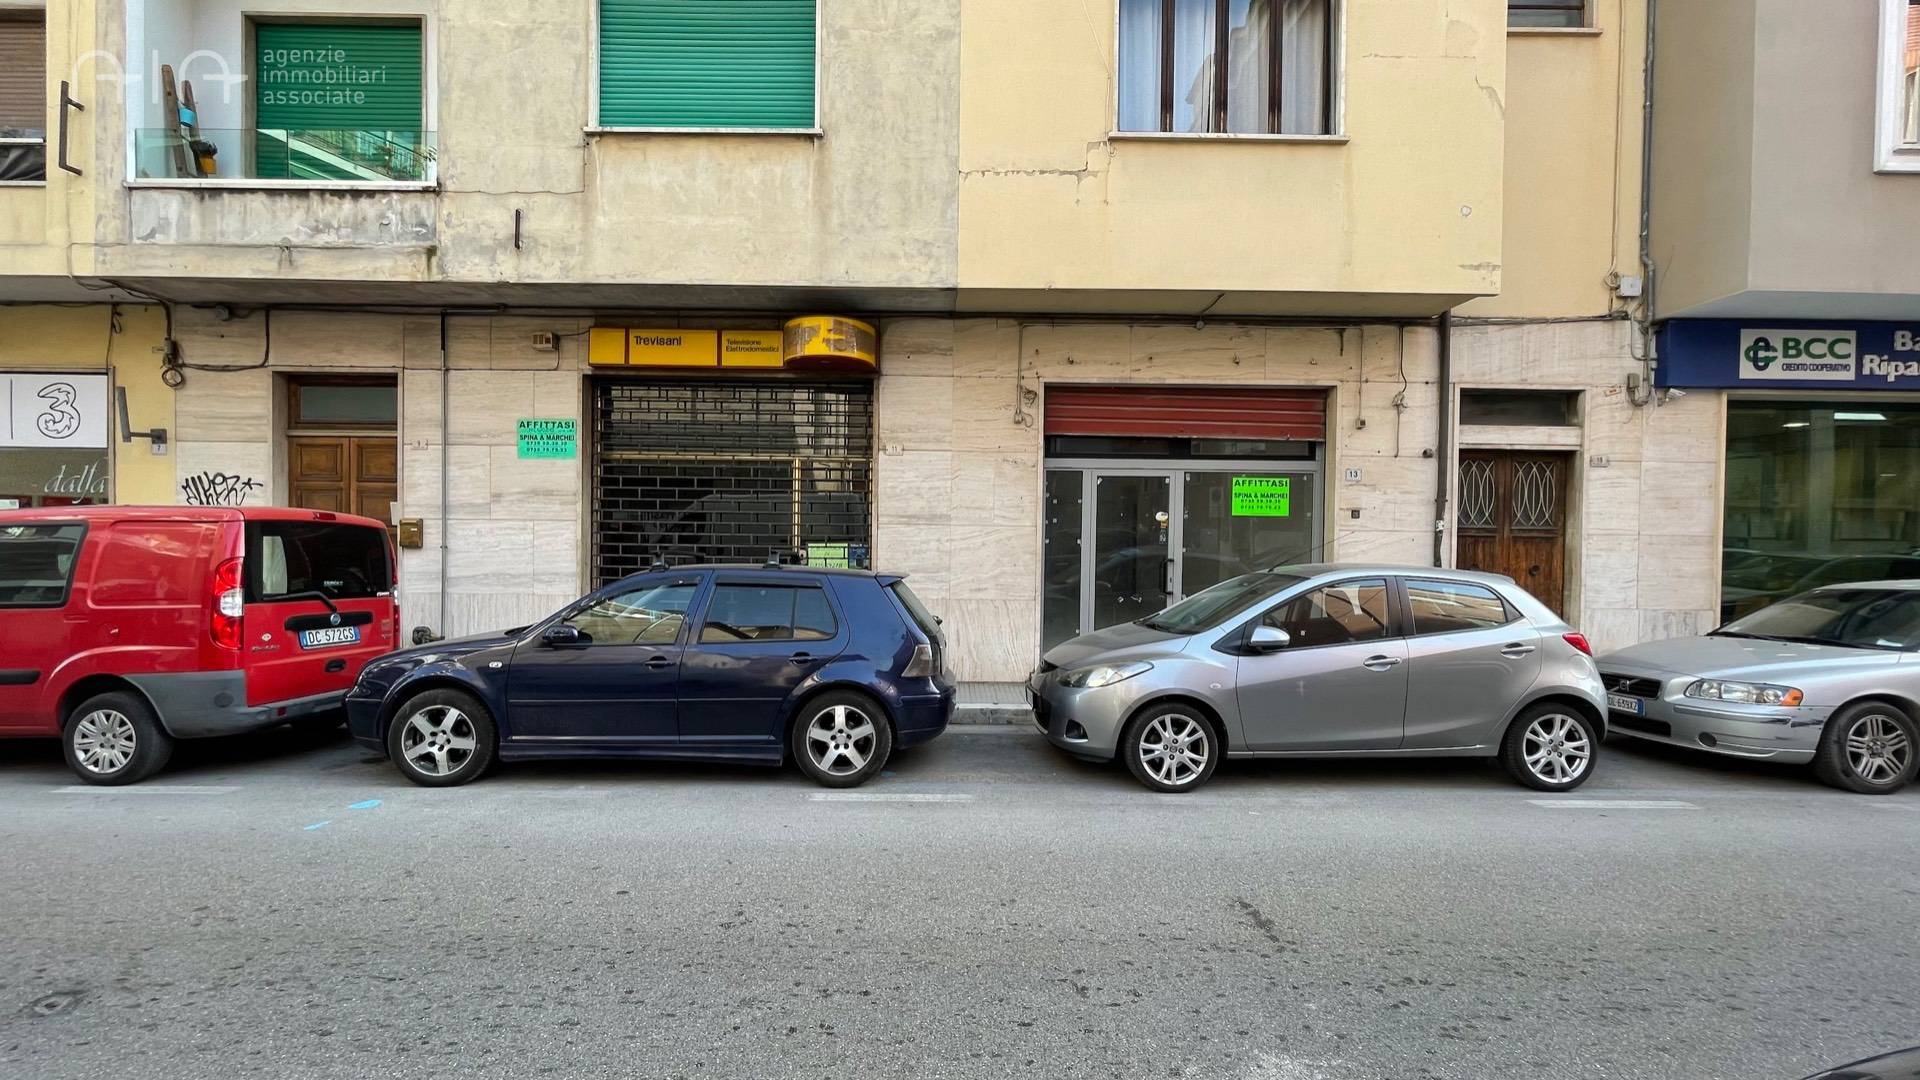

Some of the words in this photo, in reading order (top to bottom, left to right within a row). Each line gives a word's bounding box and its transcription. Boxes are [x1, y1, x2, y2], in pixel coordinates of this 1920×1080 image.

[634, 335, 682, 346] Trevisani
[725, 345, 780, 353] Elettrodomestici
[1782, 337, 1851, 359] BCC
[1782, 363, 1808, 371] CREDITO
[1809, 363, 1851, 372] COOPERATIVO
[1862, 355, 1920, 382] Ripa
[520, 421, 575, 429] AFFITTASI
[1349, 470, 1358, 478] 13
[1234, 479, 1288, 487] AFFITTASI
[308, 631, 322, 644] DC
